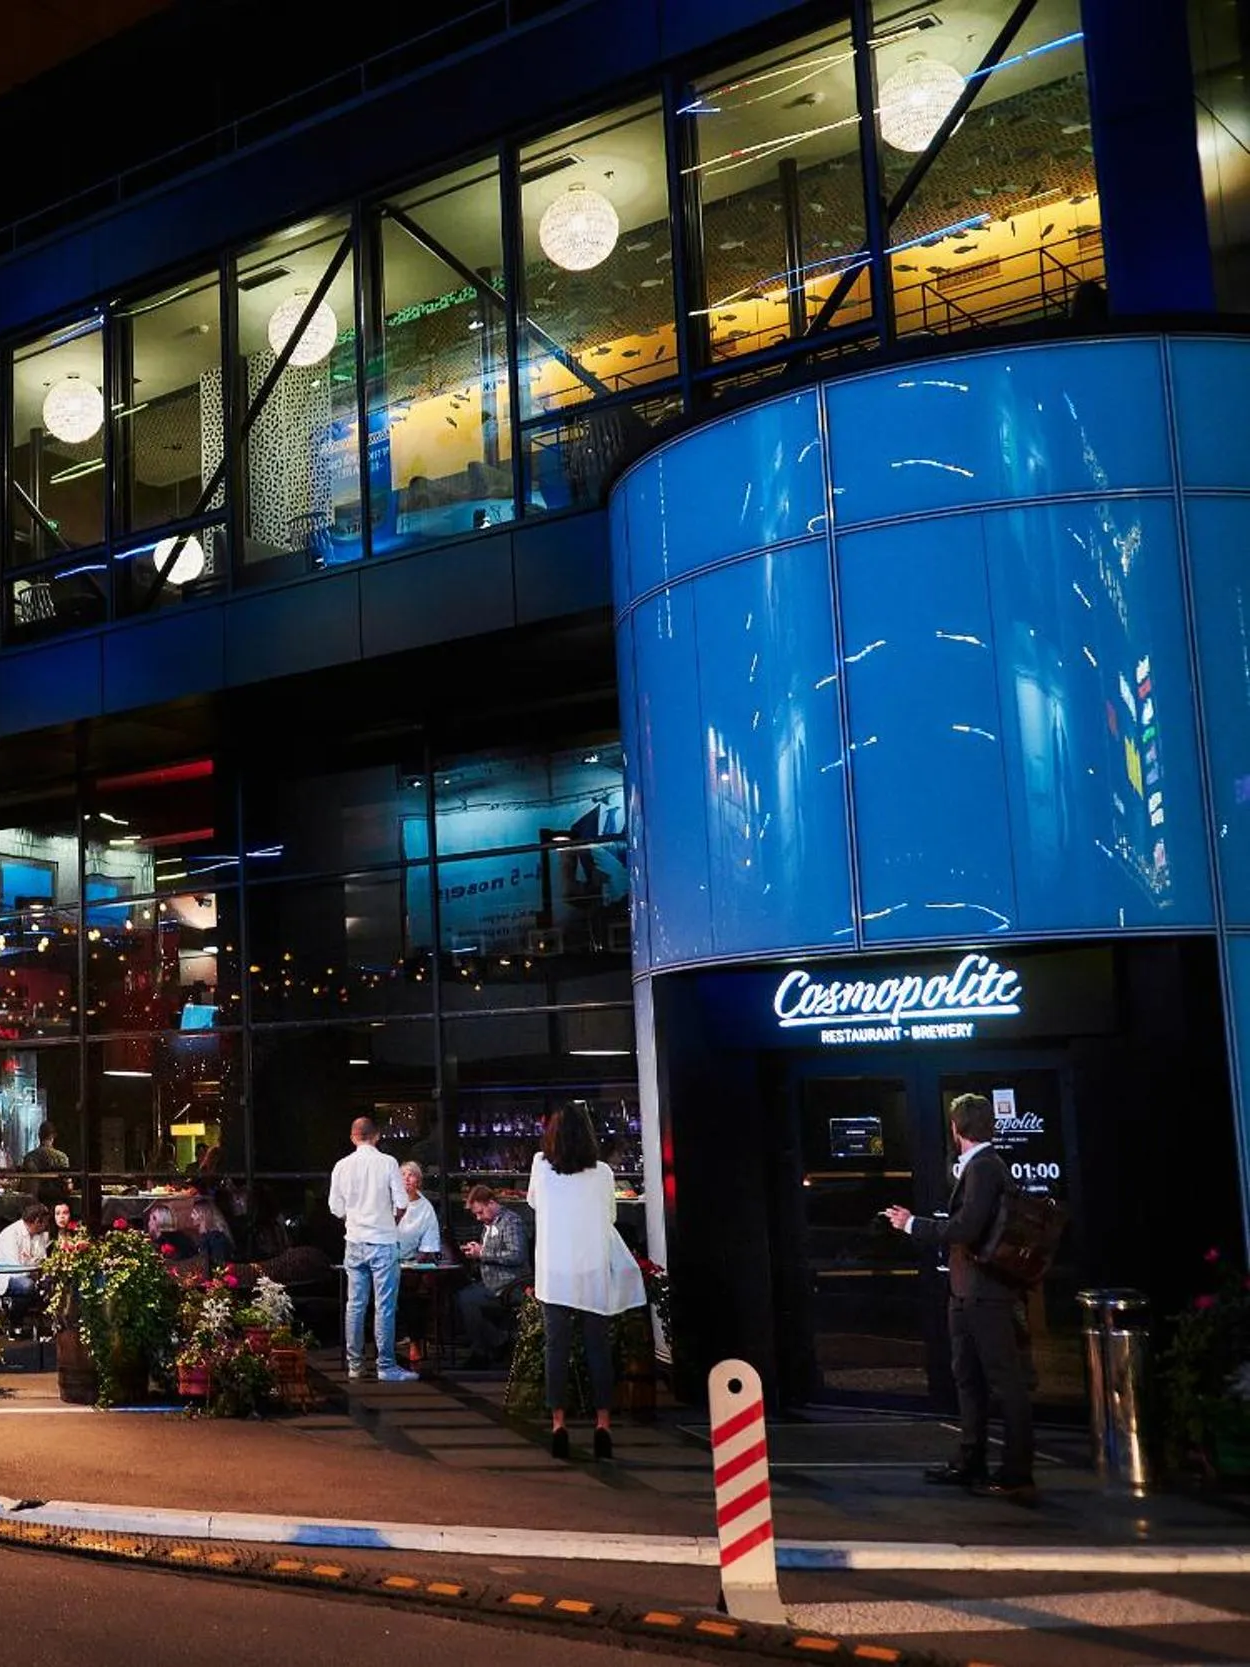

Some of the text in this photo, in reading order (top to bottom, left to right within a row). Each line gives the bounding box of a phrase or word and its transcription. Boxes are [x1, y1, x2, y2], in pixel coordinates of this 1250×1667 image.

[774, 954, 1022, 1026] Cosmopolite
[821, 1023, 974, 1043] RESTAURANT BREWERY
